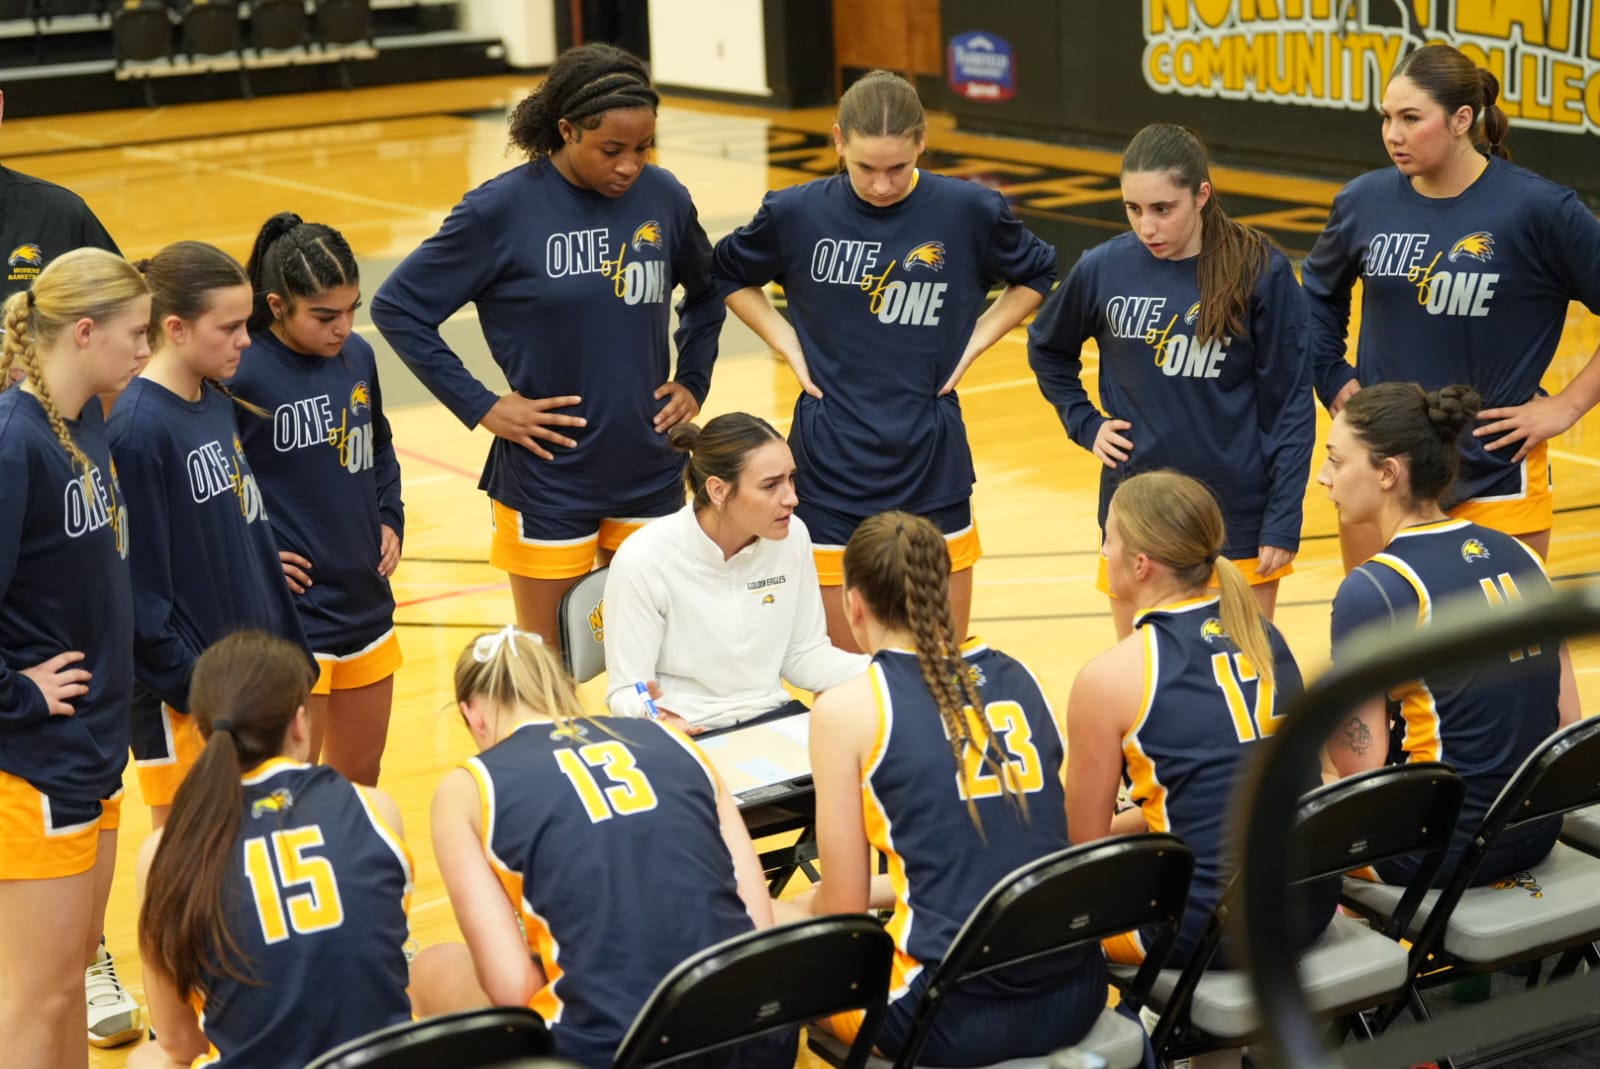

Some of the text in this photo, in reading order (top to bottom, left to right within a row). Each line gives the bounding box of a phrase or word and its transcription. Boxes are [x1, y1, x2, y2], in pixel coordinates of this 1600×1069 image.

[1149, 31, 1401, 102] COMMUNITY
[546, 228, 610, 278] ONE
[600, 242, 640, 298] of
[810, 238, 882, 285] ONE
[1366, 230, 1430, 276] ONE
[1407, 251, 1449, 305] of
[860, 259, 901, 314] of
[878, 280, 949, 326] ONE
[1426, 270, 1500, 317] ONE
[1106, 295, 1167, 339] ONE
[1145, 313, 1182, 367] of
[1162, 334, 1232, 379] ONE
[274, 394, 337, 452] ONE
[328, 407, 359, 467] of
[347, 421, 374, 474] ON
[187, 440, 236, 504] ONE
[766, 575, 787, 586] EAGLES
[1211, 651, 1288, 743] 12
[941, 700, 1044, 801] 23
[553, 741, 658, 824] 13
[243, 824, 344, 945] 15
